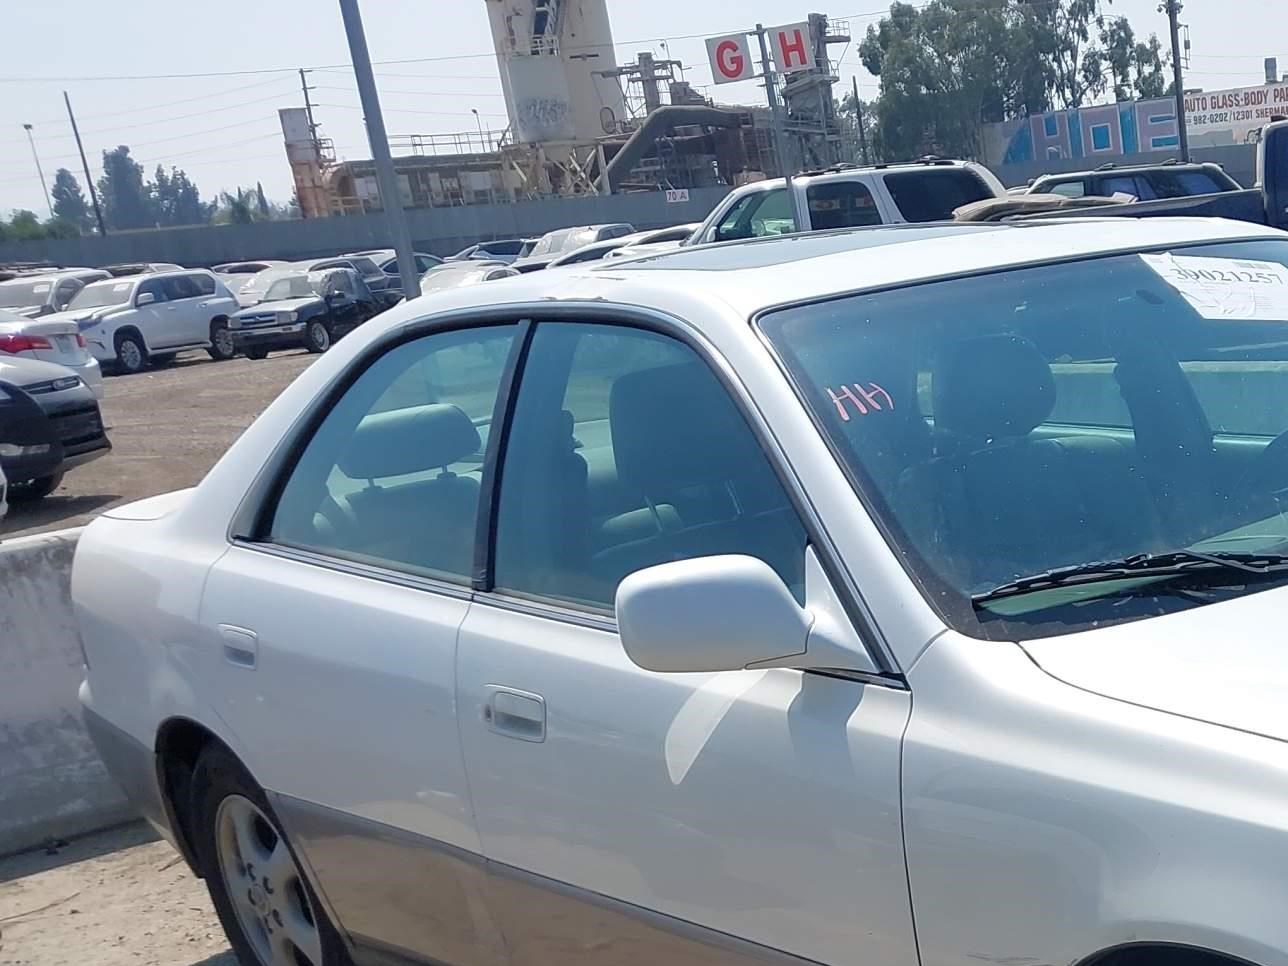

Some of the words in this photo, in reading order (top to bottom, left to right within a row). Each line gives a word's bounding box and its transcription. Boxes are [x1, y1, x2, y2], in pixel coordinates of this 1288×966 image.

[715, 40, 744, 79] G
[778, 29, 807, 68] H
[1184, 96, 1207, 113] AUTO
[1169, 267, 1284, 286] 39021257
